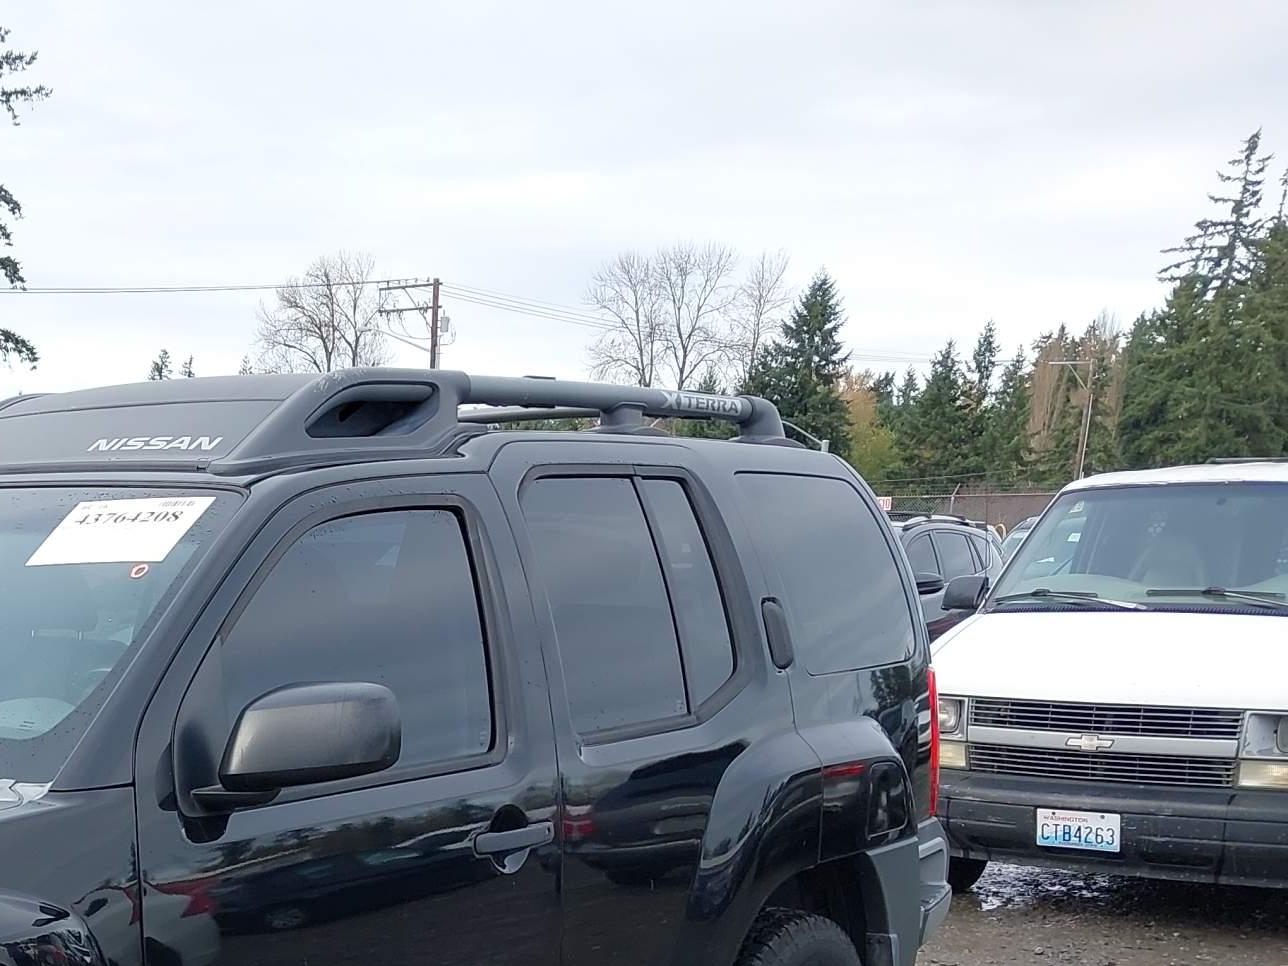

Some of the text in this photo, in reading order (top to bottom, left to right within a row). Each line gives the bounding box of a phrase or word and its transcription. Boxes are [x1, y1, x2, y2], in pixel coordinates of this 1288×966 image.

[87, 436, 223, 451] NISSAN
[75, 510, 184, 525] 43764208
[1041, 823, 1115, 845] CTB4263
